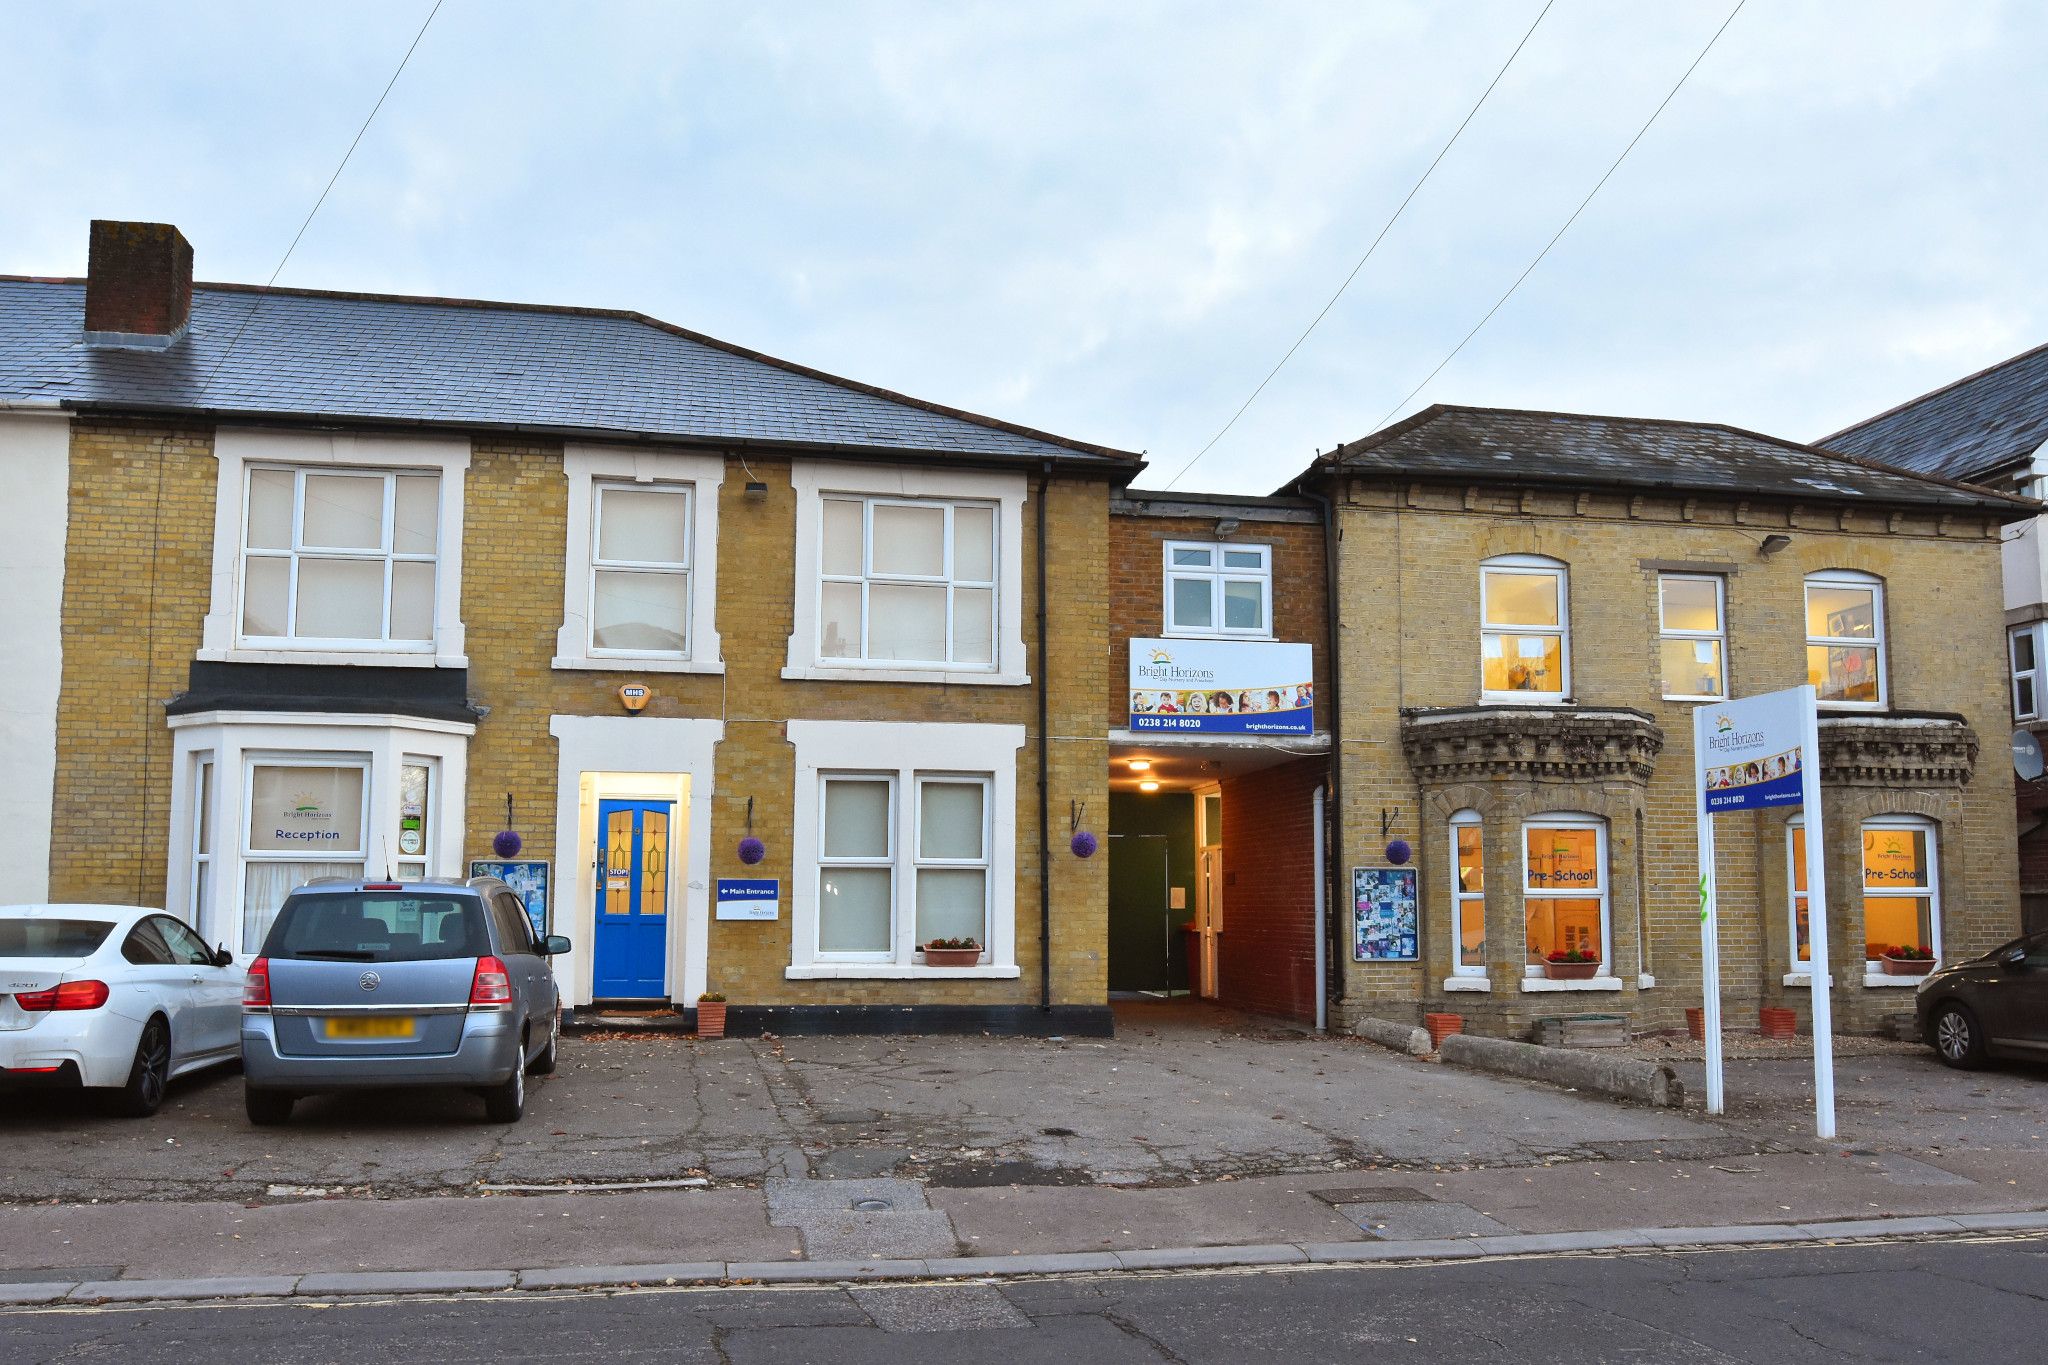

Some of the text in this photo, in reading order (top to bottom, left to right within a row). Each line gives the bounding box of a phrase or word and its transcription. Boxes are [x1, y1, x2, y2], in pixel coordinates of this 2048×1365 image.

[1139, 665, 1214, 679] Bright Horizons
[1138, 718, 1201, 728] 0238 214 8020
[1245, 723, 1306, 731] brighthorizons.co.uk
[1709, 731, 1764, 749] Bright Horizons
[1710, 798, 1723, 806] 0238
[1723, 796, 1732, 805] 214
[283, 811, 303, 819] Bright
[275, 829, 340, 842] Reception
[1528, 869, 1593, 881] Pre-School
[1865, 868, 1924, 880] Pre-School
